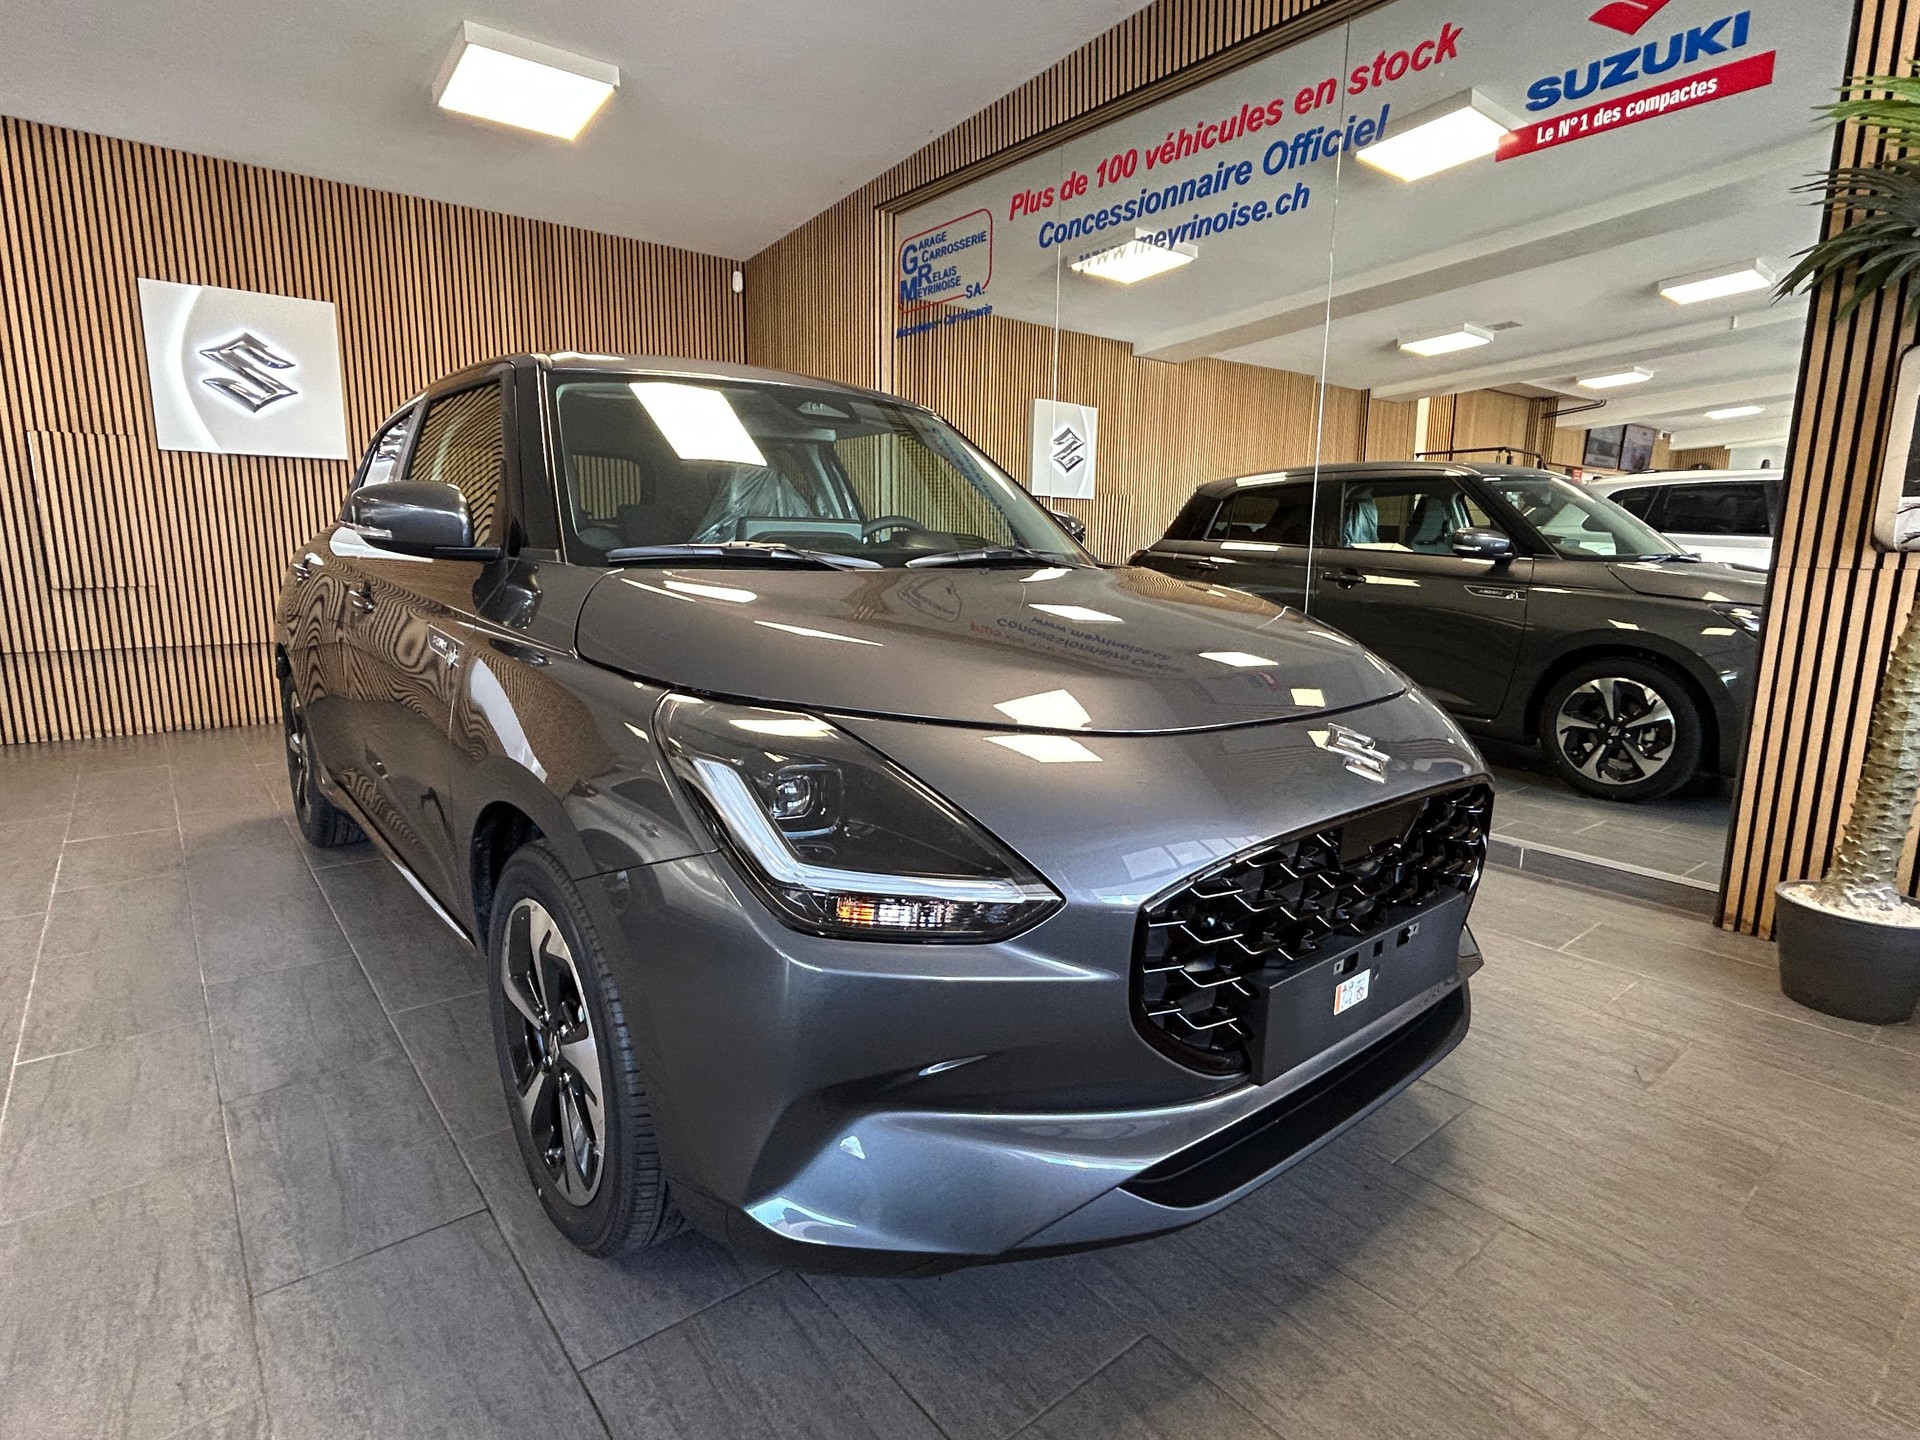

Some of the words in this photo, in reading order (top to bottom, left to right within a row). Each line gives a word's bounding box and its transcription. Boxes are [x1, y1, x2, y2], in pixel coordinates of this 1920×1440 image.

[1525, 10, 1750, 112] SUZUKI
[1009, 186, 1055, 221] Plus
[1059, 171, 1088, 201] de
[1096, 148, 1138, 188] 100
[1145, 98, 1285, 171] véhicules
[1293, 77, 1337, 114] en
[1347, 22, 1464, 96] stock
[1536, 126, 1554, 144] Le
[1593, 107, 1621, 128] des
[1625, 77, 1718, 118] compactes
[1039, 160, 1253, 249] Concessionnaire
[1262, 103, 1391, 176] Officiel
[917, 263, 957, 288] RELAIS
[921, 230, 987, 263] CARROSSERIE
[900, 275, 962, 304] MEYRINOISE
